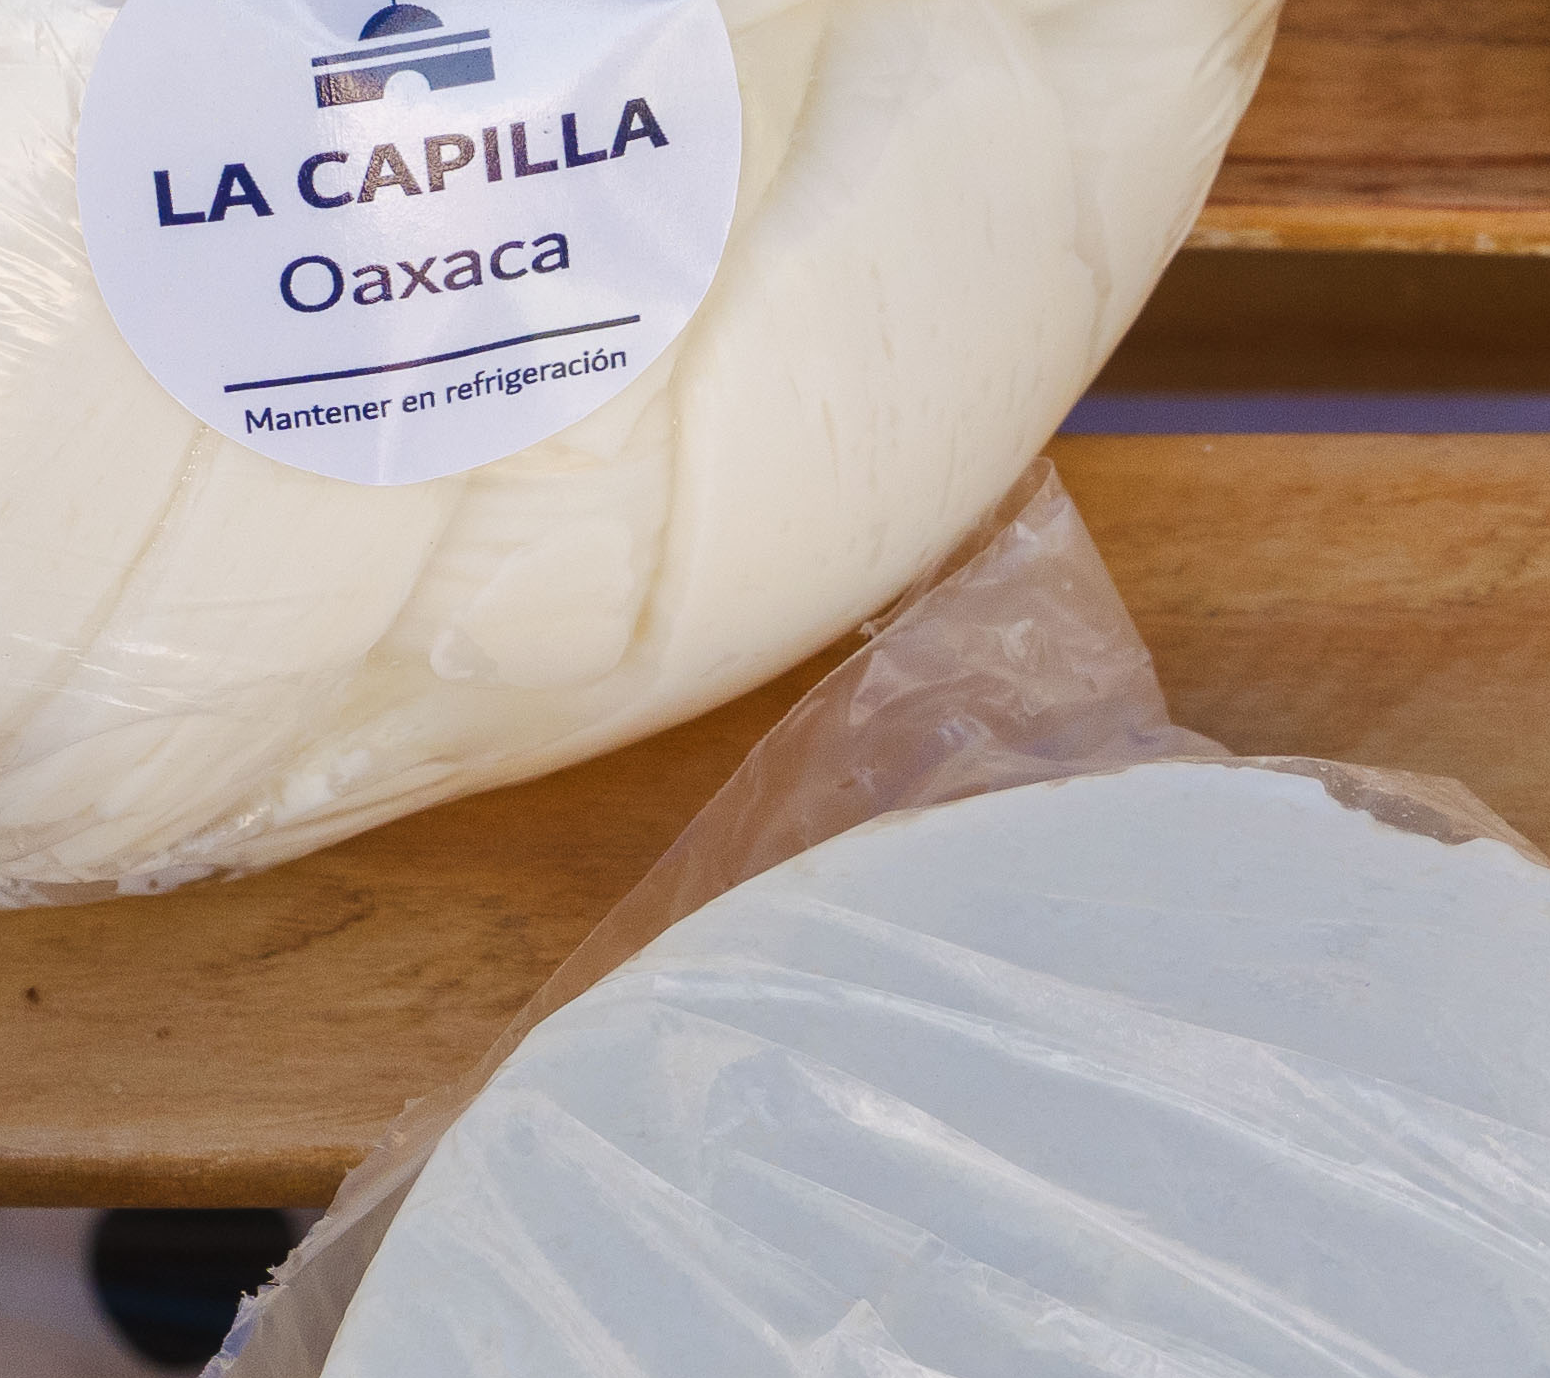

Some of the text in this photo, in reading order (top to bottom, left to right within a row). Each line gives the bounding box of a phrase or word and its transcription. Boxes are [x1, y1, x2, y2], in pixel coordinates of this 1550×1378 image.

[153, 96, 670, 228] LA CAPILLA
[279, 231, 571, 314] Oaxaca
[243, 346, 628, 435] Mantener en refrigeración
